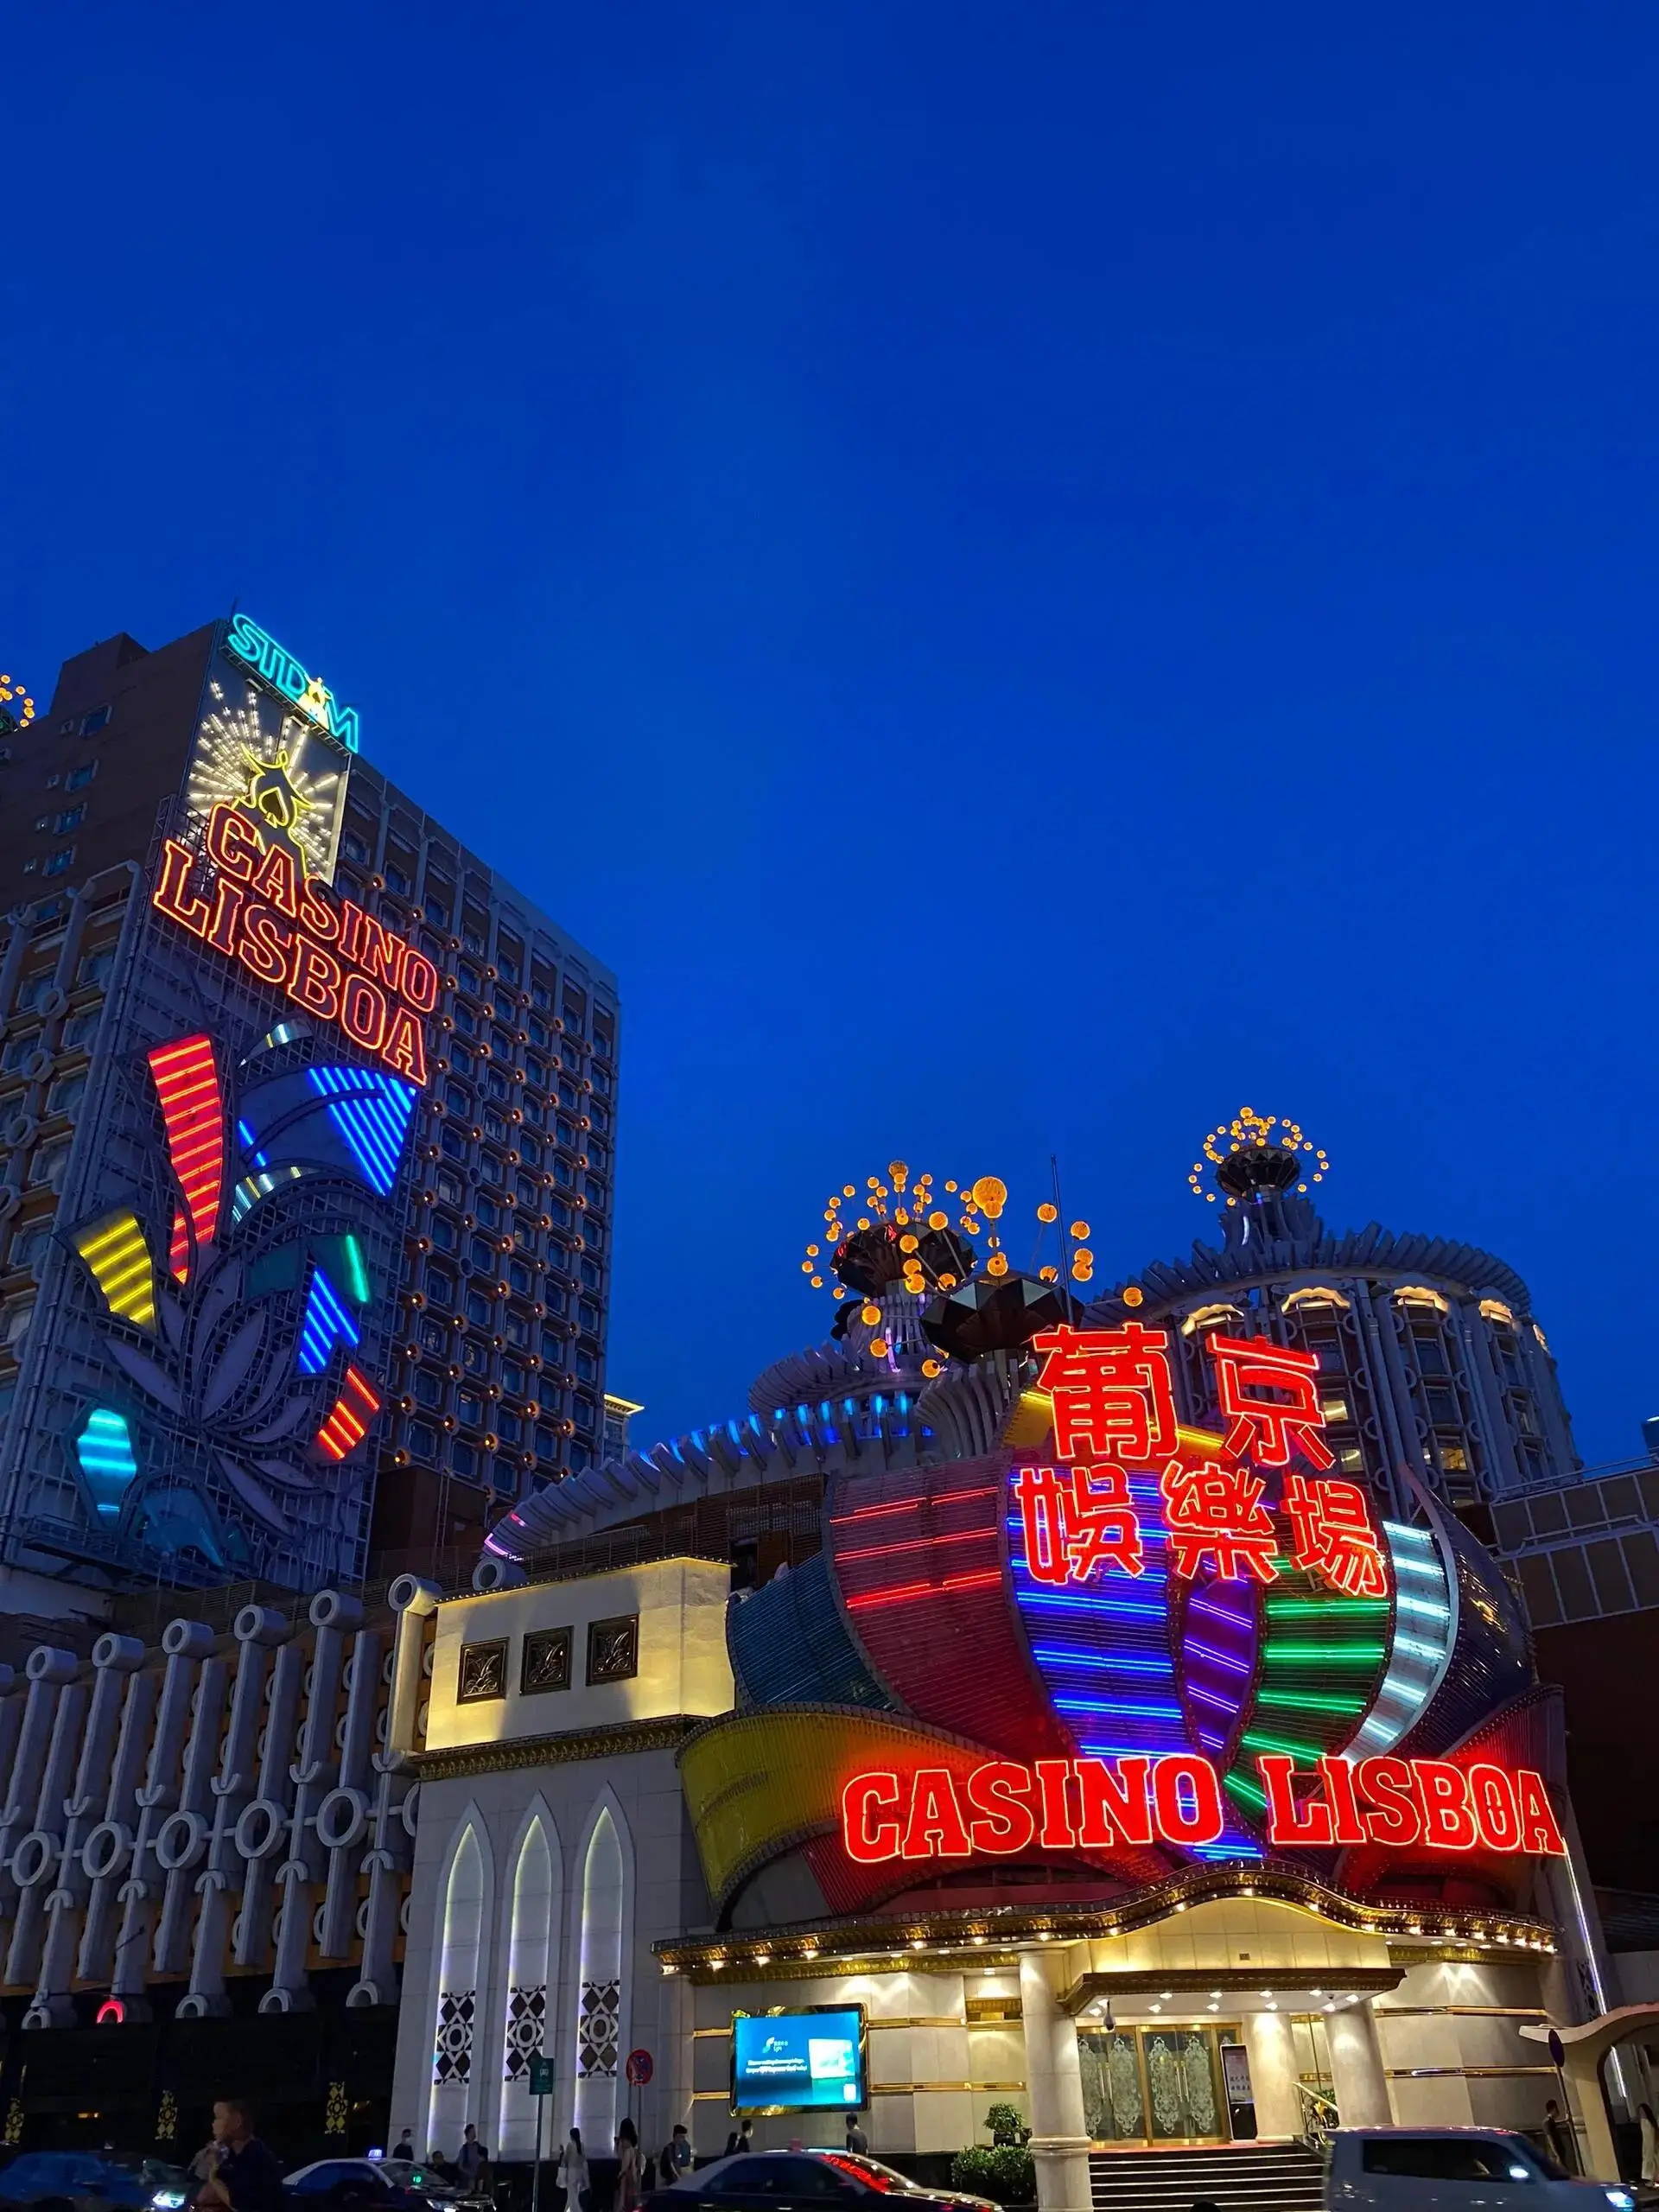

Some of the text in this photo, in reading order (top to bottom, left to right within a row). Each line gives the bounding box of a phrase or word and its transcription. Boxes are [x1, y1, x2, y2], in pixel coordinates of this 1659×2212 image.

[153, 839, 428, 1086] LISBOA
[207, 803, 438, 1013] CASINO
[1032, 1321, 1336, 1470] 葡京
[841, 1755, 1566, 1864] CASINO LISBOA
